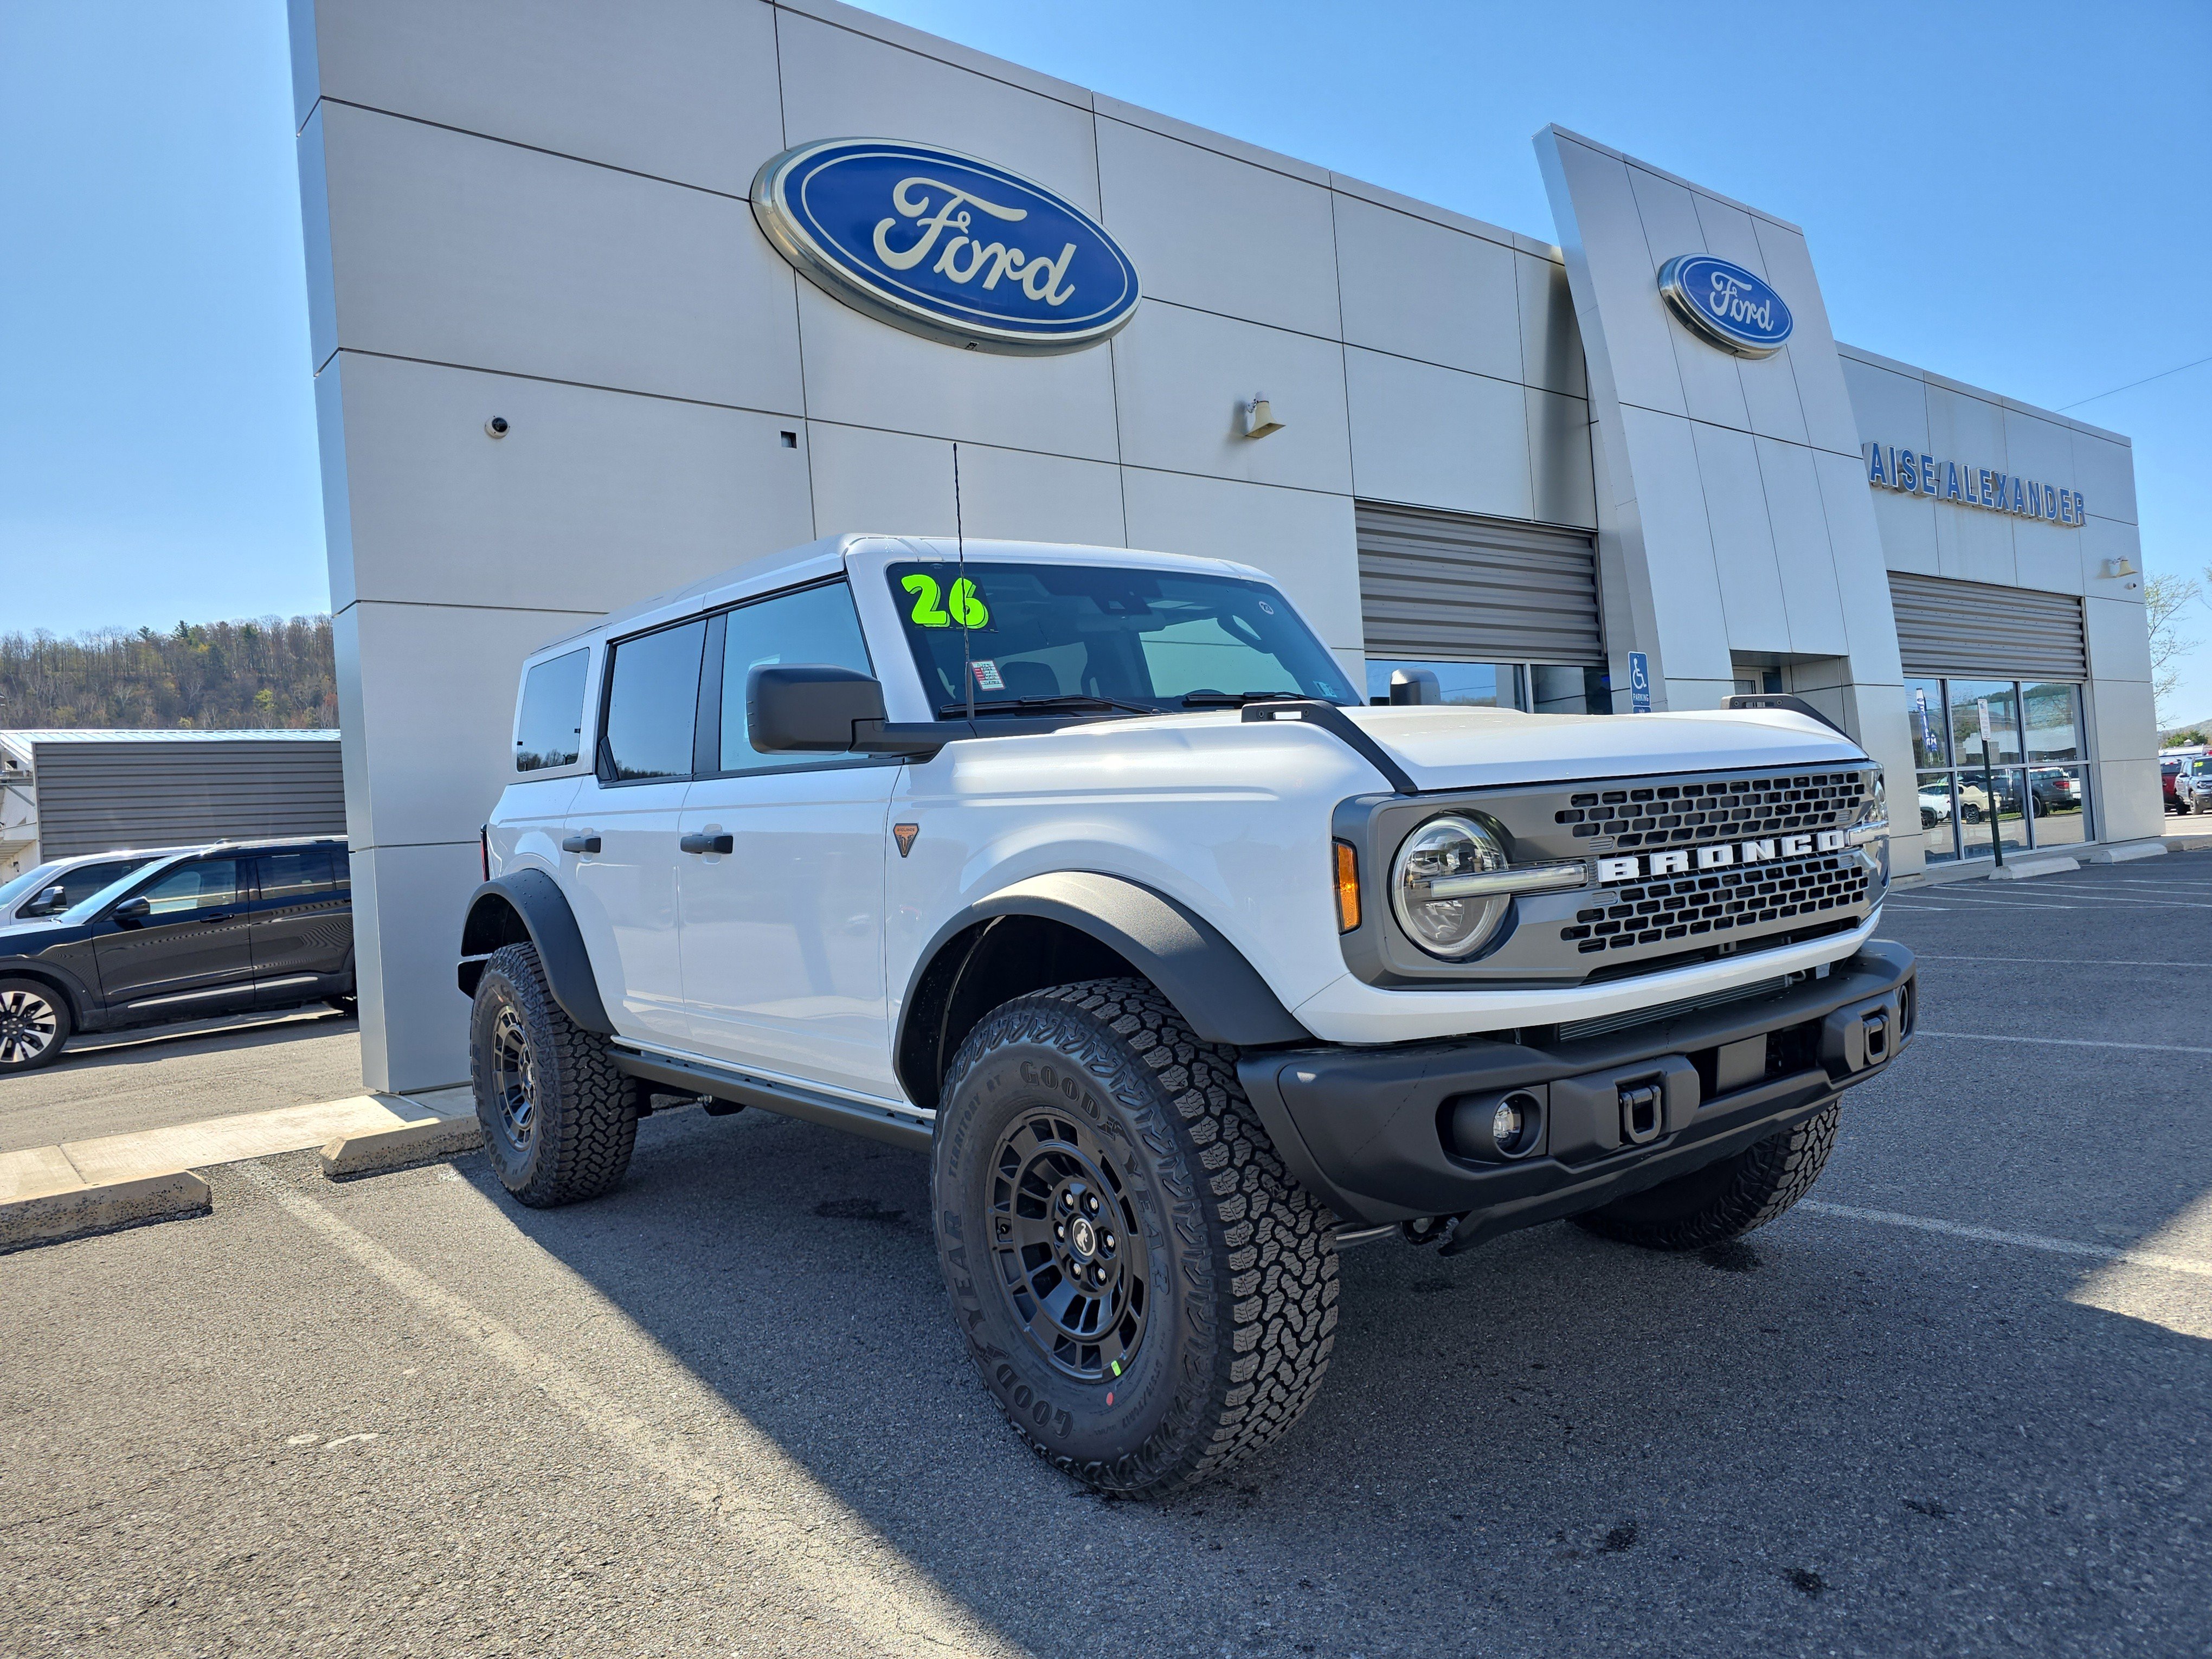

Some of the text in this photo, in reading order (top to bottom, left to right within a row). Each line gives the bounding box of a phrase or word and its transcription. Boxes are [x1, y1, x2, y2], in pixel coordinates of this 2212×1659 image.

[873, 177, 1077, 306] Ford
[1710, 272, 1773, 331] Ford
[1944, 461, 2086, 526] ALEXANDER
[901, 574, 989, 629] 26
[1632, 693, 1649, 702] PARKING
[1597, 831, 1844, 883] BRONCO
[948, 1075, 1001, 1178] TERRITORY RT
